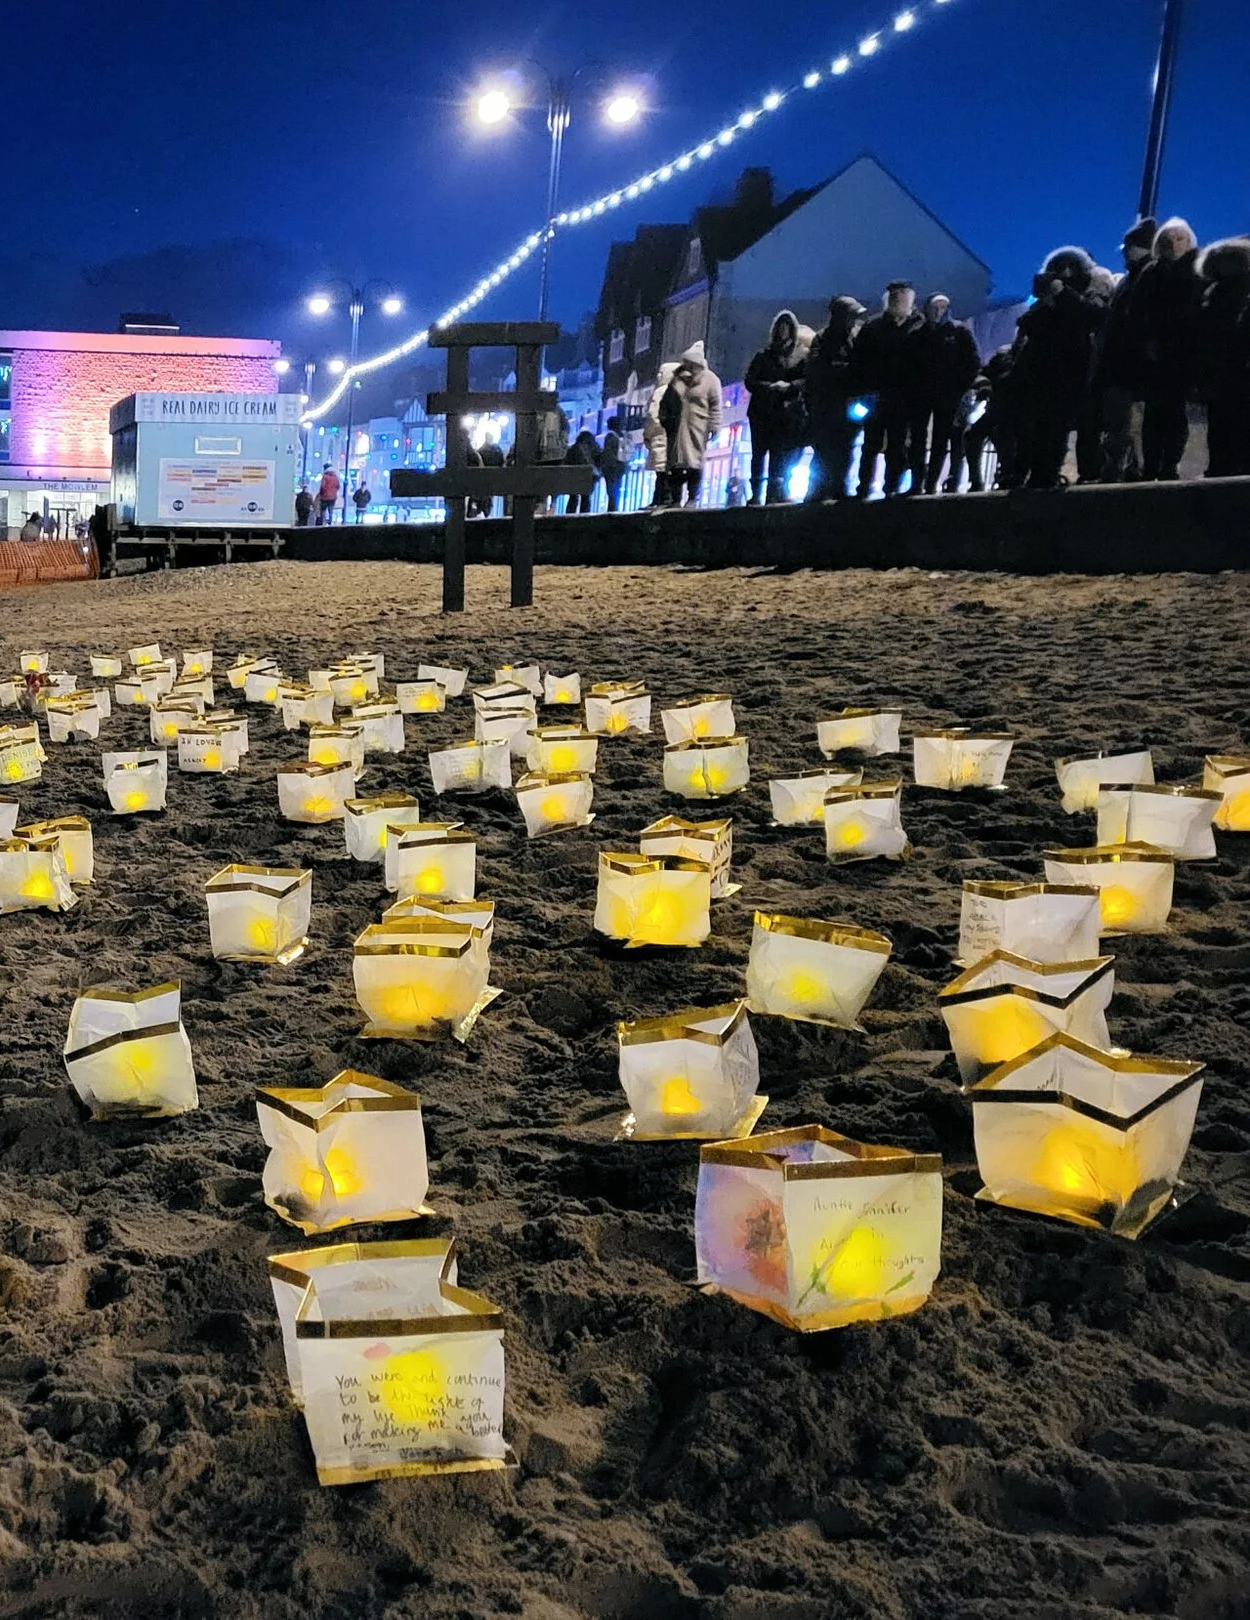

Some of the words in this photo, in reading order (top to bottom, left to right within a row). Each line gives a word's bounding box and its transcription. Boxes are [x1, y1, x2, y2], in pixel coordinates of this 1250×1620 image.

[162, 400, 186, 415] REAL
[190, 400, 220, 415] DAIRY
[224, 401, 239, 415] ICE
[244, 401, 277, 416] CREAM
[43, 482, 59, 490] THE
[335, 1375, 362, 1390] You
[446, 1373, 501, 1388] continue
[340, 1392, 358, 1406] to
[341, 1412, 364, 1431] my
[428, 1419, 452, 1431] me
